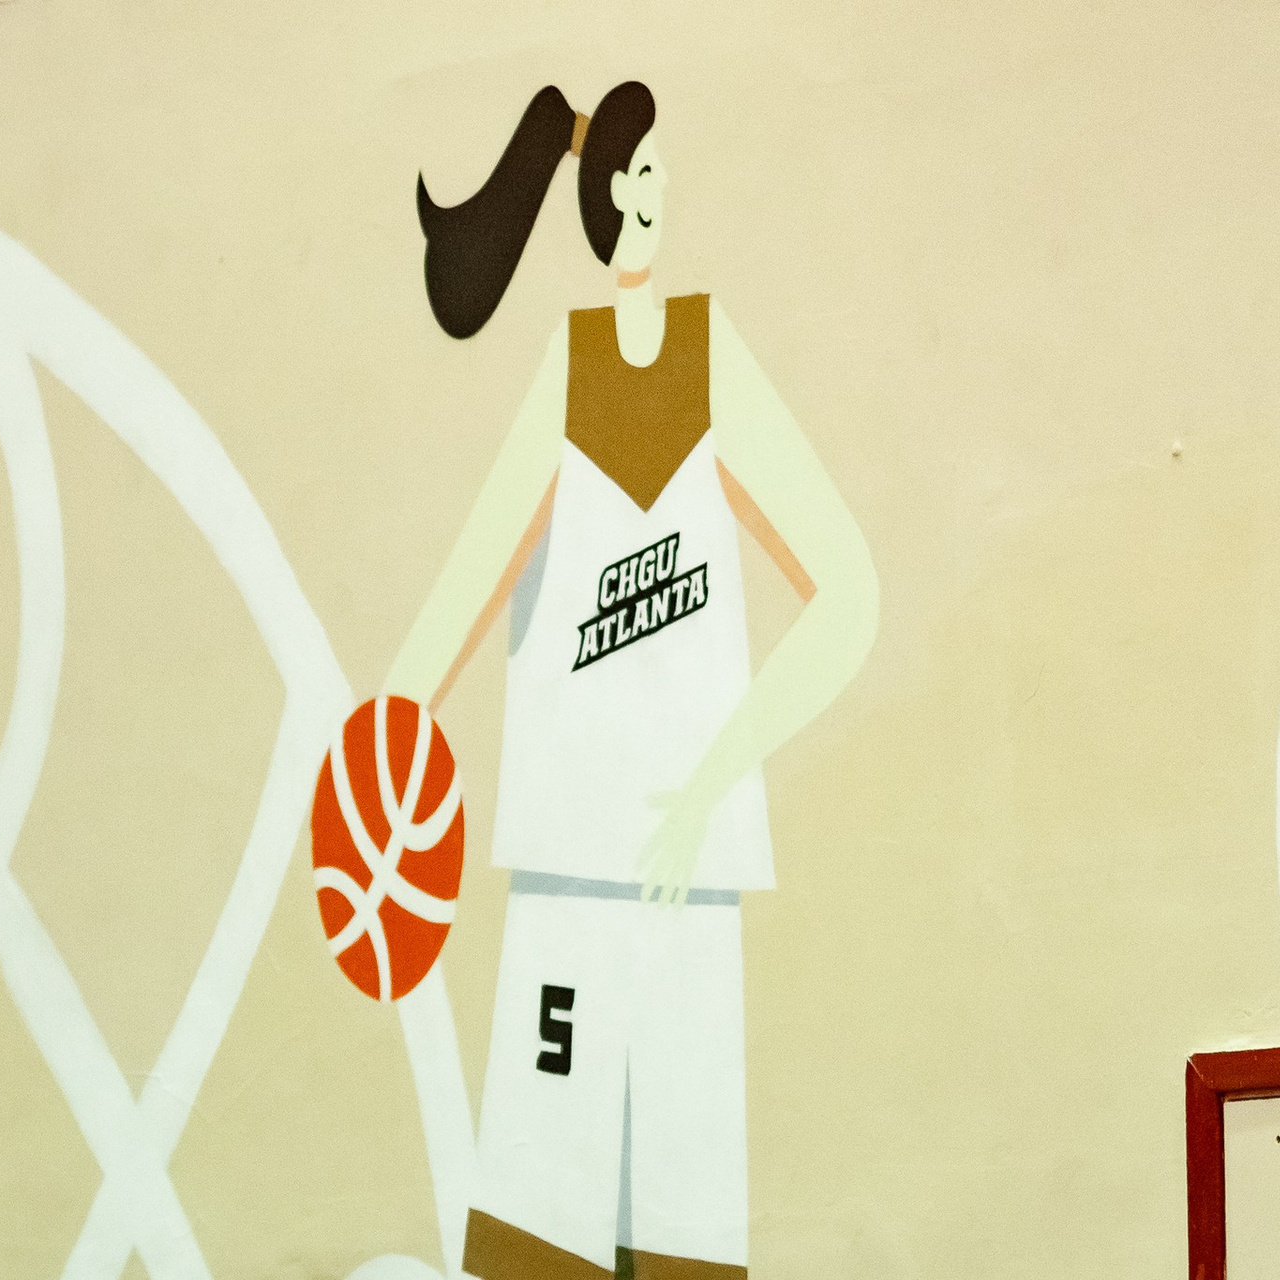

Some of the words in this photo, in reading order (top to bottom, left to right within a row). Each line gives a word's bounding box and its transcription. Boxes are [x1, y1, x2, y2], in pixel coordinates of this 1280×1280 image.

[577, 567, 706, 665] ATLANTA
[599, 537, 678, 609] CHGU
[536, 984, 575, 1076] 5
